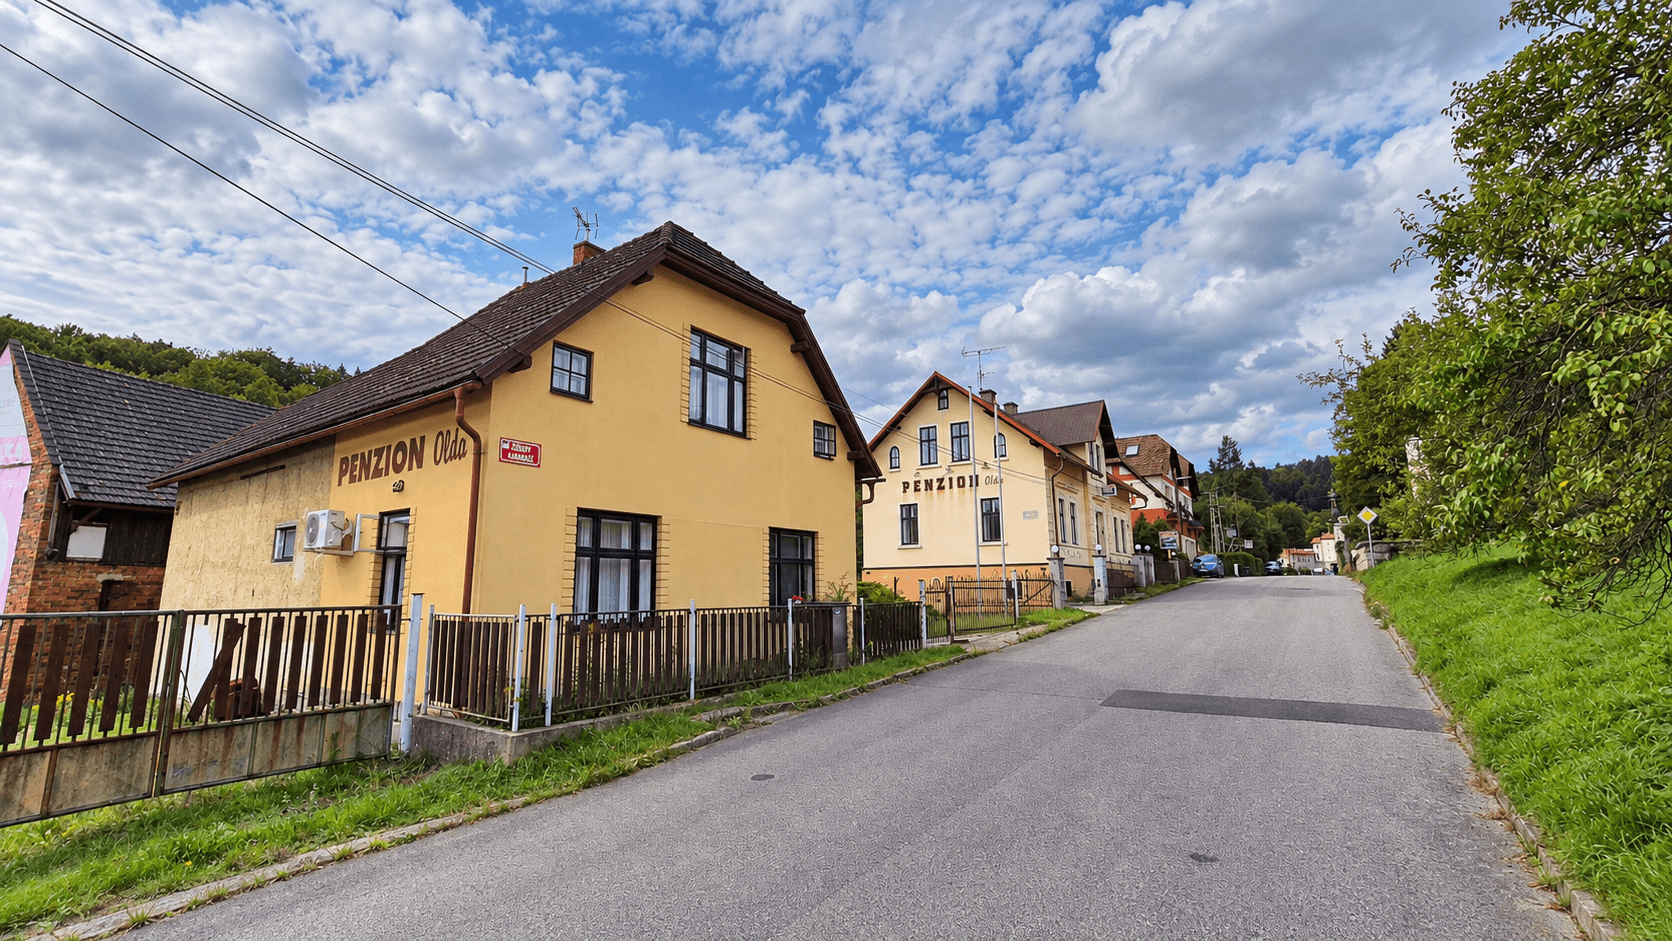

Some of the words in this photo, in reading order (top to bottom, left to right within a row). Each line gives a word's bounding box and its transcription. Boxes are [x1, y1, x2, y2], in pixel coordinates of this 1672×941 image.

[337, 435, 426, 487] PENZION
[433, 427, 468, 467] Olda
[902, 474, 979, 494] PENZION
